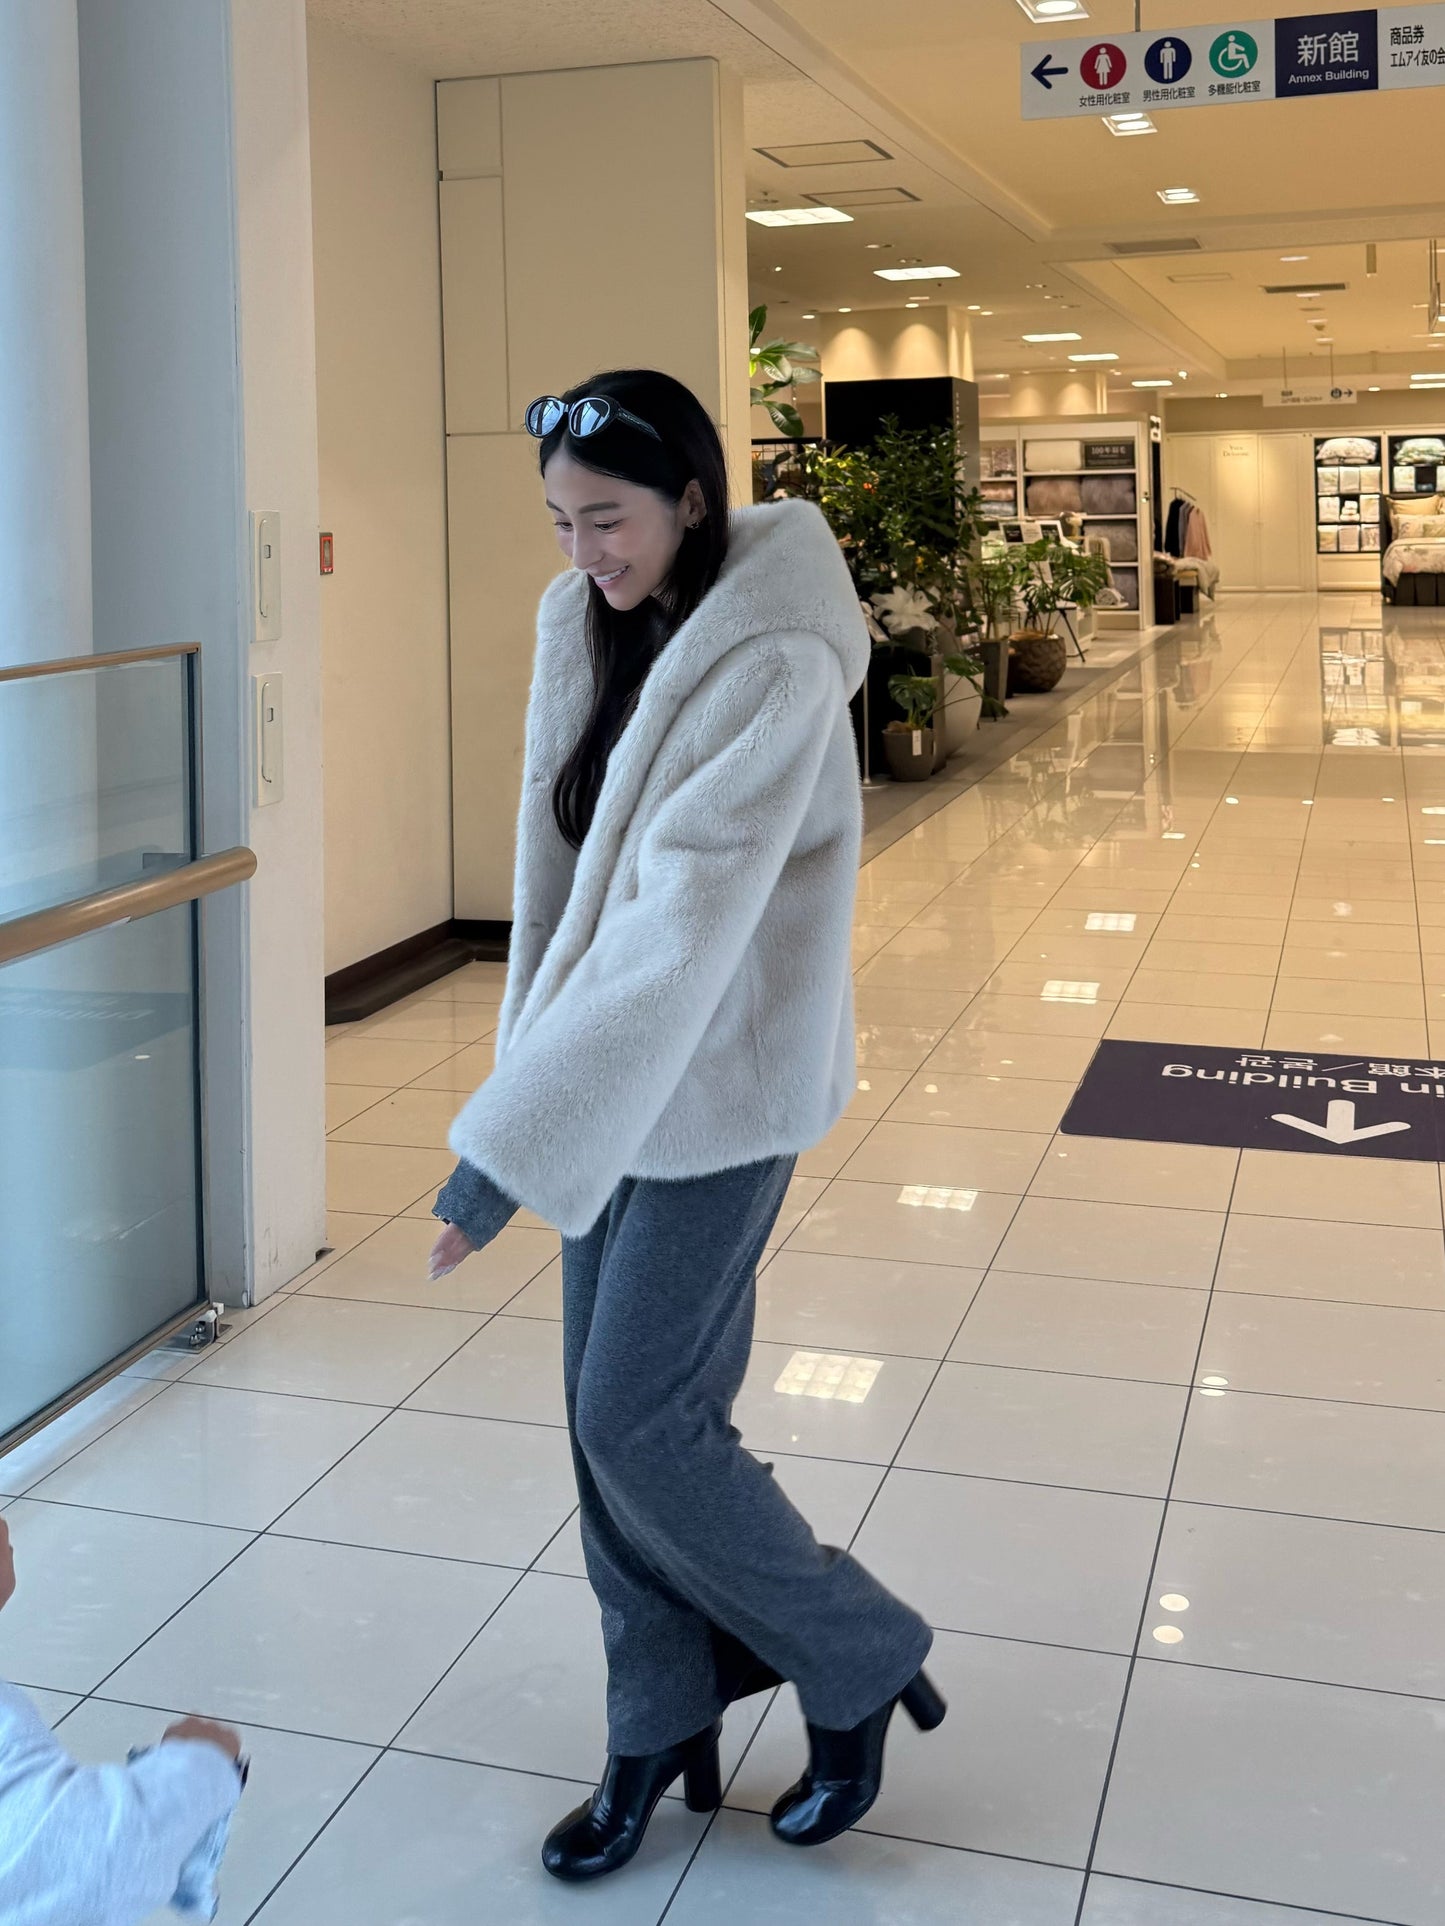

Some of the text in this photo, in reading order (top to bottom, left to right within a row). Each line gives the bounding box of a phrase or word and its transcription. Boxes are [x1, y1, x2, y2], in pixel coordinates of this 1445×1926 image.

[1390, 24, 1424, 46] 商品券
[1297, 31, 1359, 67] 新館
[1288, 69, 1370, 85] Annex Building
[1143, 86, 1195, 102] 男性用化粧室
[1208, 81, 1261, 97] 多機能化粧室
[1079, 92, 1130, 108] 女性用化粧室
[1161, 1064, 1377, 1094] Building
